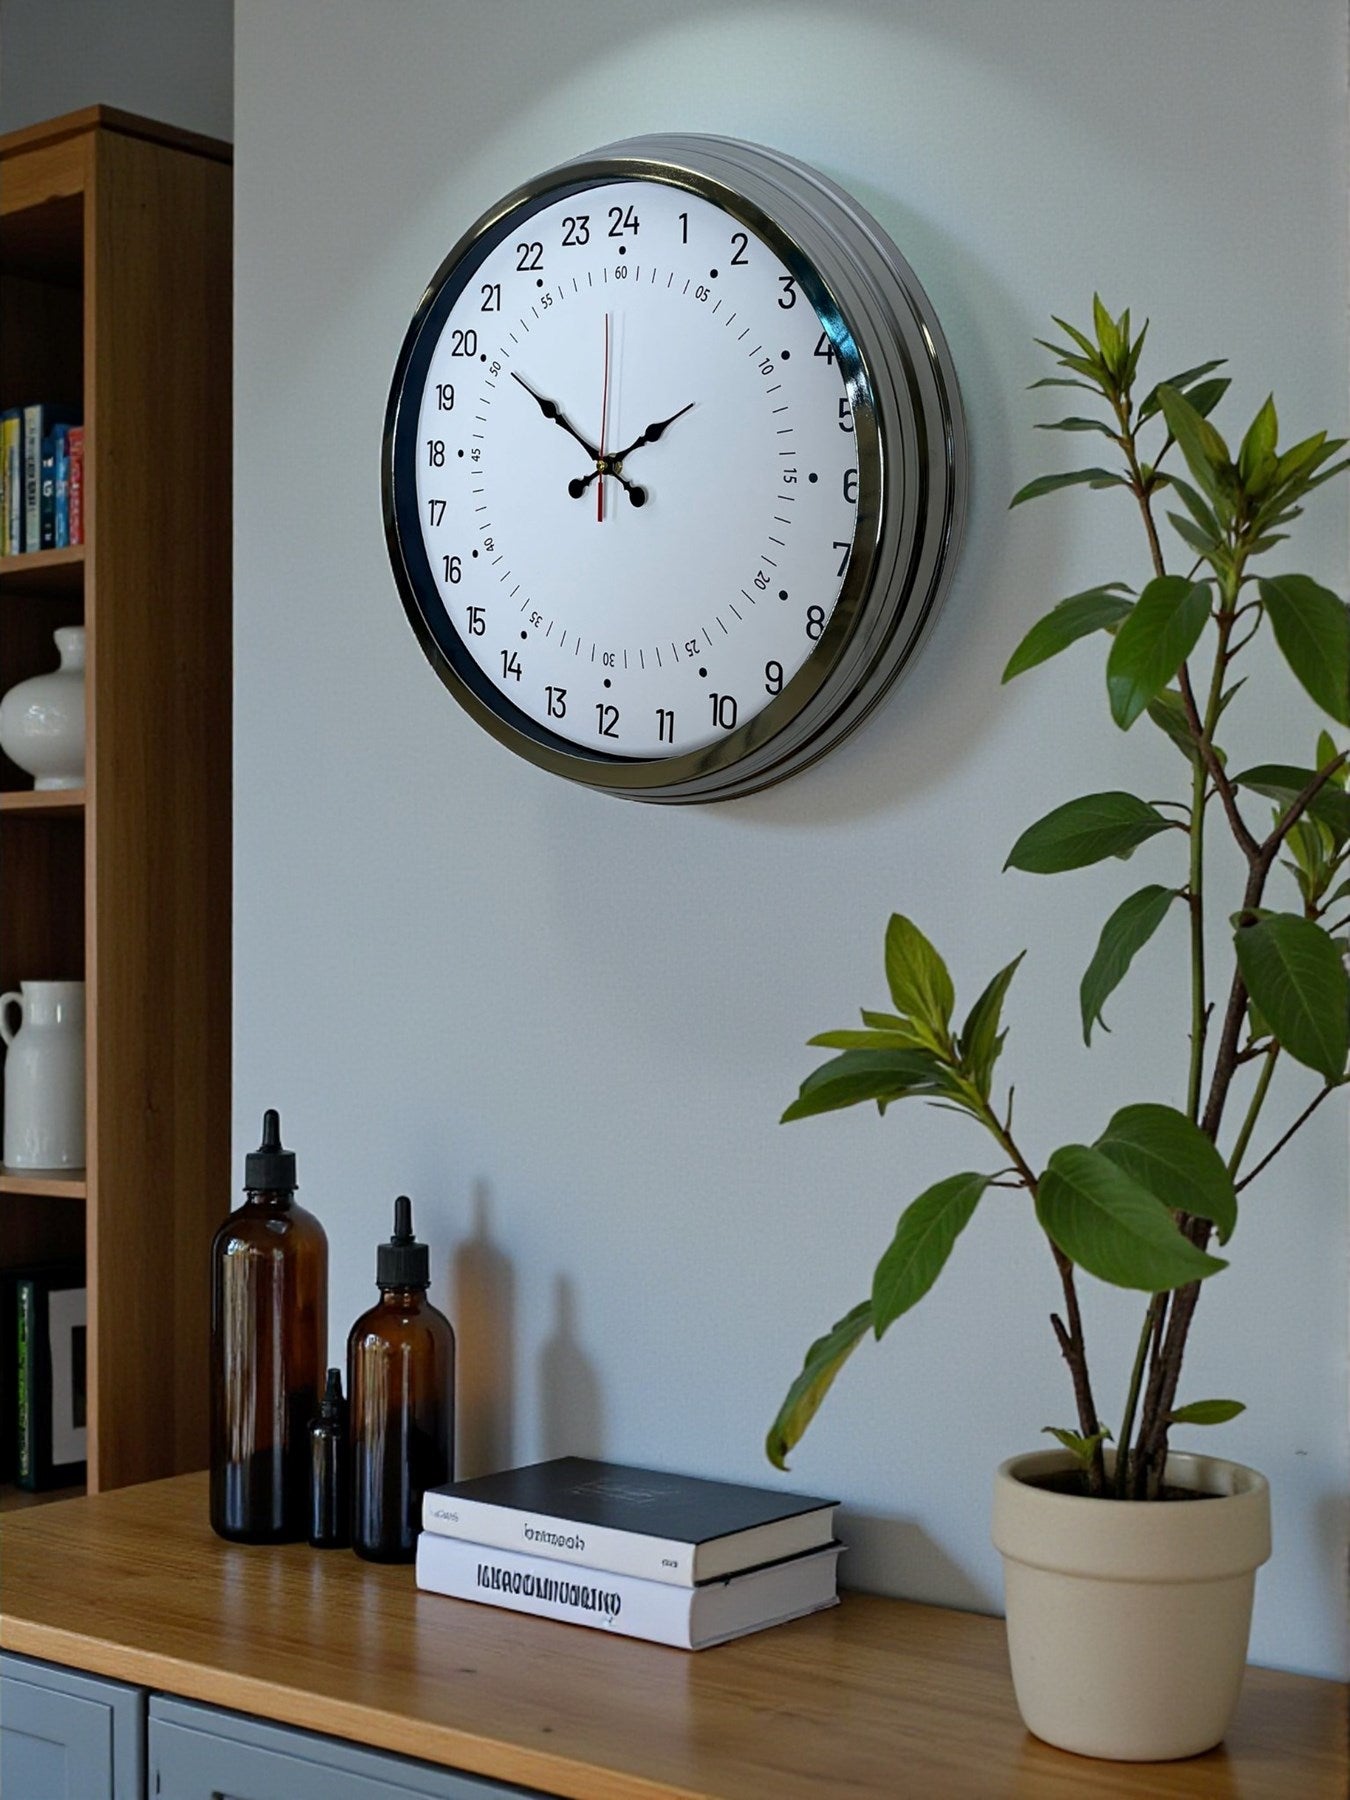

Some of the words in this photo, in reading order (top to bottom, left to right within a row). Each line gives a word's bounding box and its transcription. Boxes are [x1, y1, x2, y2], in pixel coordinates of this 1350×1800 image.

[562, 215, 589, 246] 23
[608, 205, 640, 237] 24
[679, 213, 687, 244] 1
[516, 242, 543, 271] 22
[731, 233, 748, 265] 2
[615, 266, 627, 279] 60
[481, 284, 500, 311] 21
[541, 293, 553, 309] 55
[695, 286, 710, 302] 05
[778, 276, 796, 309] 3
[452, 329, 477, 357] 20
[814, 332, 834, 365] 4
[489, 361, 501, 377] 50
[759, 358, 774, 375] 10
[436, 384, 454, 411] 19
[838, 398, 854, 432] 5
[427, 440, 445, 467] 18
[471, 449, 480, 462] 45
[783, 468, 797, 483] 15
[842, 469, 857, 504] 6
[428, 499, 446, 526] 17
[484, 538, 494, 551] 40
[833, 541, 851, 577] 7
[443, 555, 461, 584] 16
[754, 570, 770, 590] 20
[466, 606, 485, 636] 15
[529, 612, 543, 628] 35
[806, 605, 825, 640] 8
[603, 652, 615, 667] 30
[685, 639, 700, 657] 25
[501, 650, 522, 681] 14
[765, 660, 783, 696] 9
[545, 686, 567, 718] 13
[709, 693, 738, 730] 10
[596, 704, 619, 738] 12
[656, 709, 674, 743] 11
